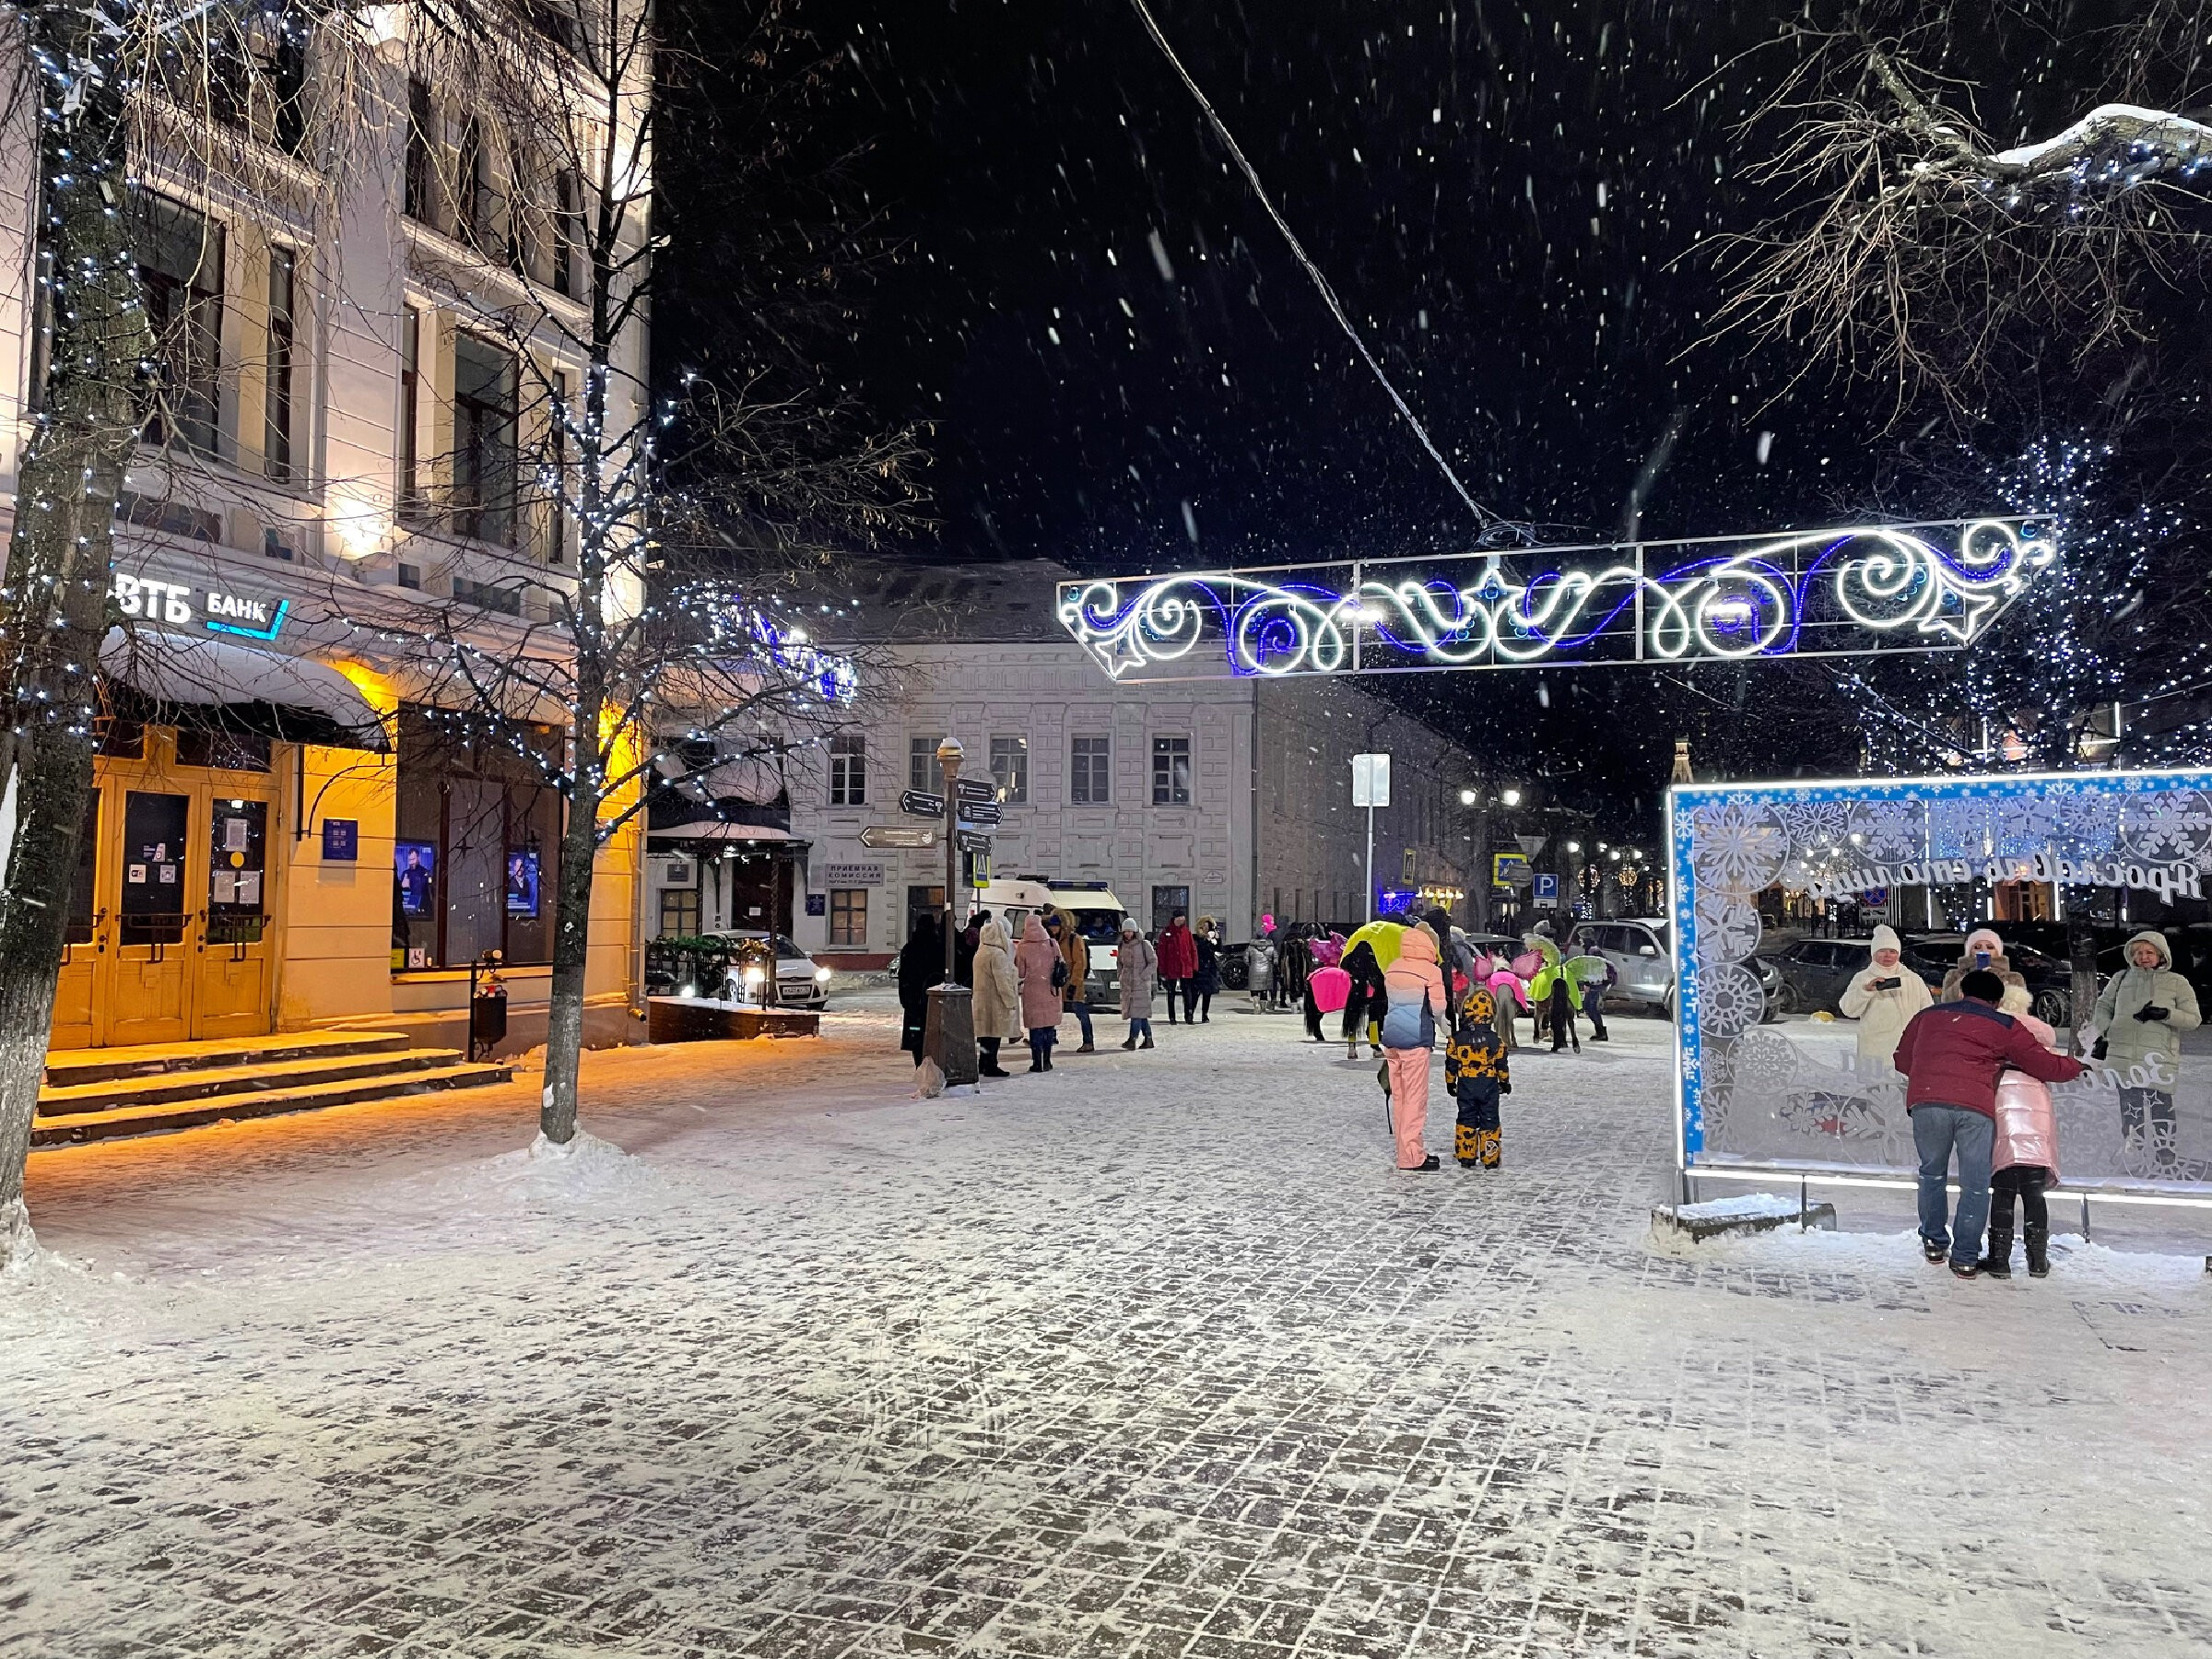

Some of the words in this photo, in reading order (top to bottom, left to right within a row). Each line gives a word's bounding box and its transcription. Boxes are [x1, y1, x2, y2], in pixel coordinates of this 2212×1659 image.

[115, 573, 191, 623] ВТБ
[207, 592, 266, 623] БАНК
[1540, 877, 1554, 895] P
